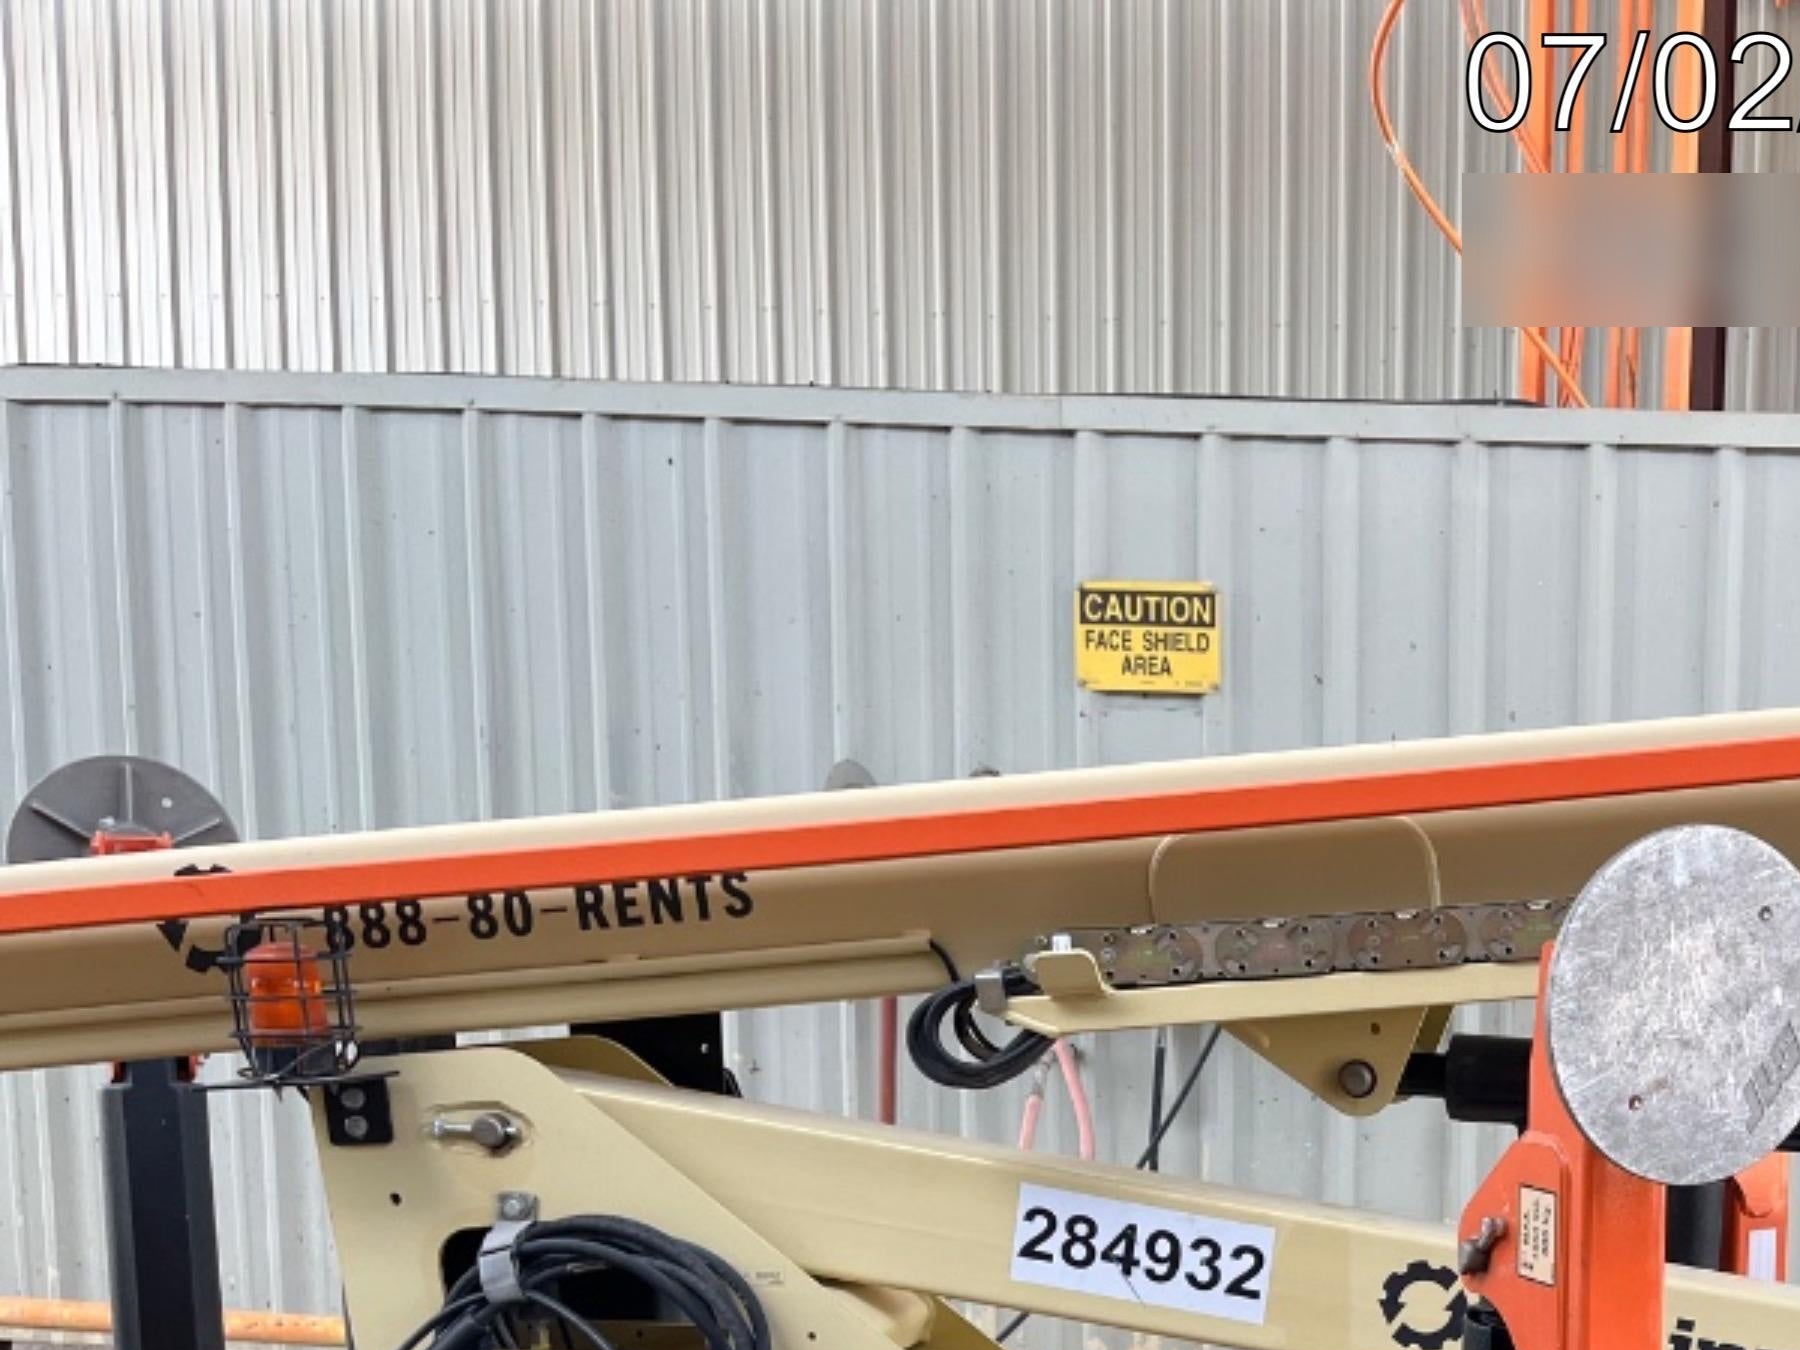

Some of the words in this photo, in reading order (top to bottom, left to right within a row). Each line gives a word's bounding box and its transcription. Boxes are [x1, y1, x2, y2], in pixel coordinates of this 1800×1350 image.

[1084, 593, 1211, 625] CAUTION
[1085, 629, 1132, 652] FACE
[1142, 631, 1210, 653] SHIELD
[1121, 654, 1172, 677] AREA
[1017, 1206, 1265, 1300] 284932
